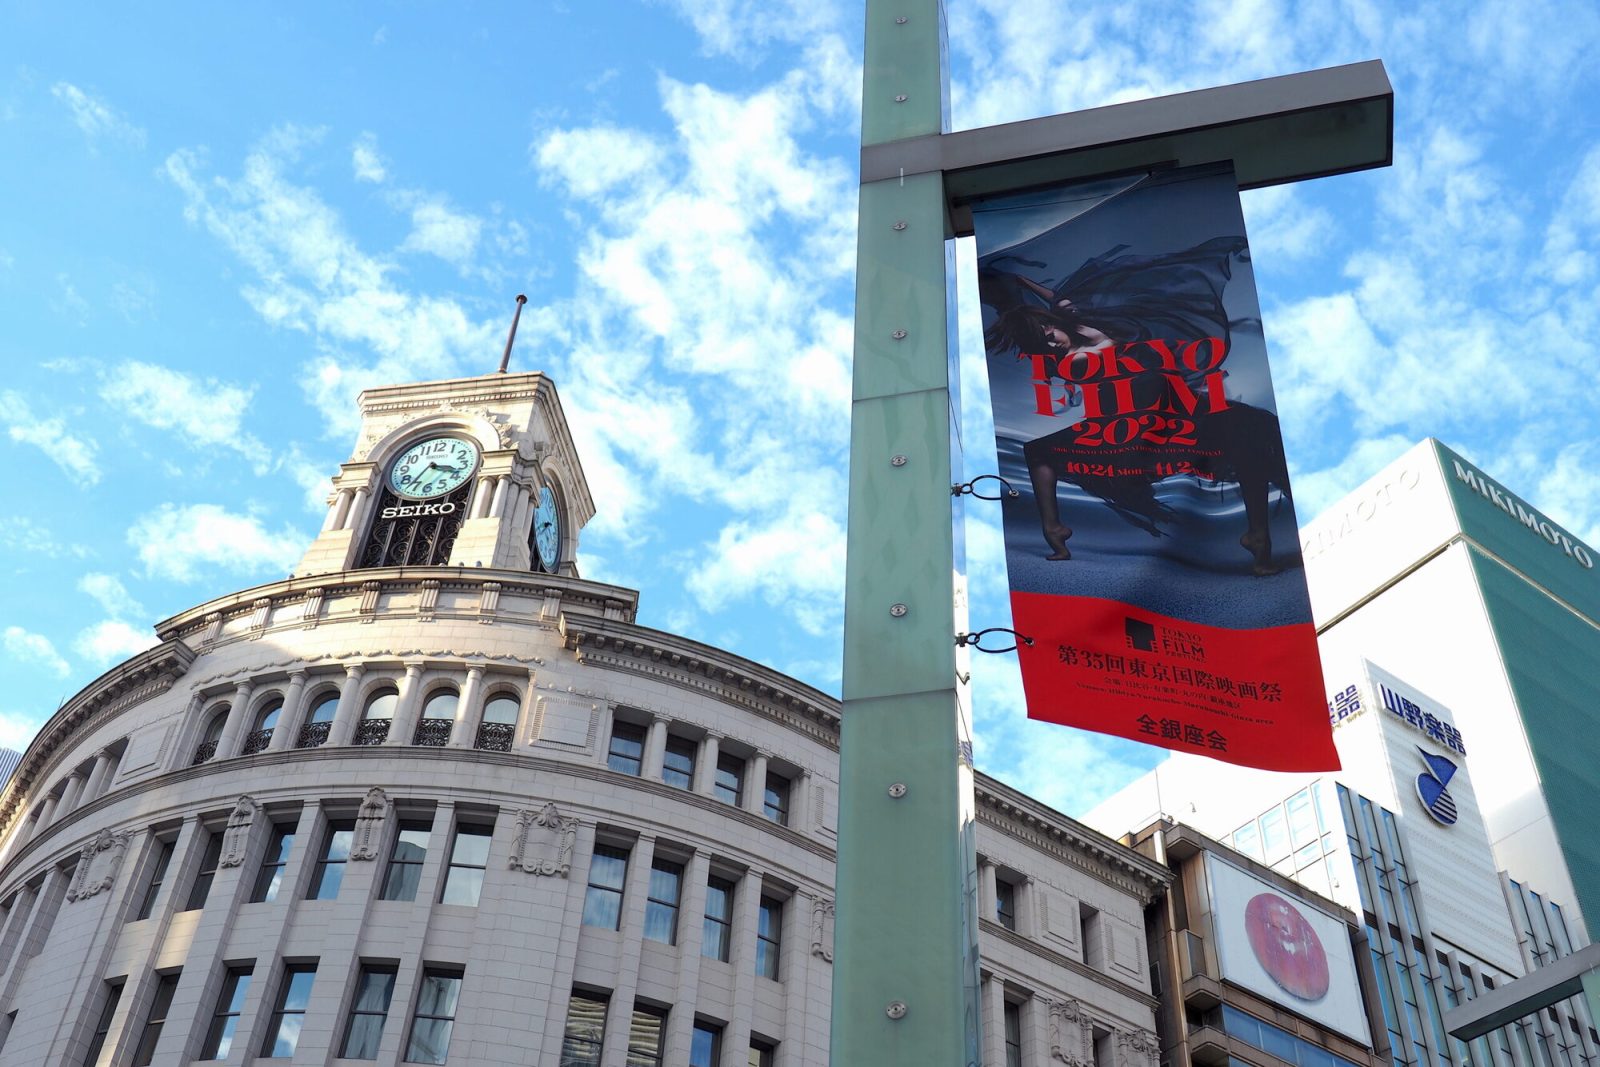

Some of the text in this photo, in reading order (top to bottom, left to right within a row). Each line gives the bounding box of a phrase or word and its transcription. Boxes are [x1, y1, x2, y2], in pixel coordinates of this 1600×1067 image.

[1020, 337, 1226, 381] TOKYO
[1032, 371, 1232, 417] FILM
[1072, 414, 1198, 446] 2022
[420, 446, 431, 455] 11
[433, 442, 447, 452] 12
[450, 444, 456, 454] 1
[406, 454, 419, 464] 10
[457, 450, 467, 460] 2
[400, 465, 410, 475] 9
[458, 460, 468, 470] 3
[400, 474, 412, 485] 8
[449, 470, 460, 480] 4
[412, 480, 422, 492] 7
[422, 482, 433, 493] 6
[436, 479, 447, 489] 5
[381, 503, 455, 518] SEIKO
[1452, 459, 1593, 568] MIKIMOTO
[1163, 639, 1205, 658] FILM
[1057, 644, 1283, 702] 第35回東京国際映画祭
[1379, 683, 1466, 756] 山野楽器
[1136, 713, 1229, 752] 全銀座会
